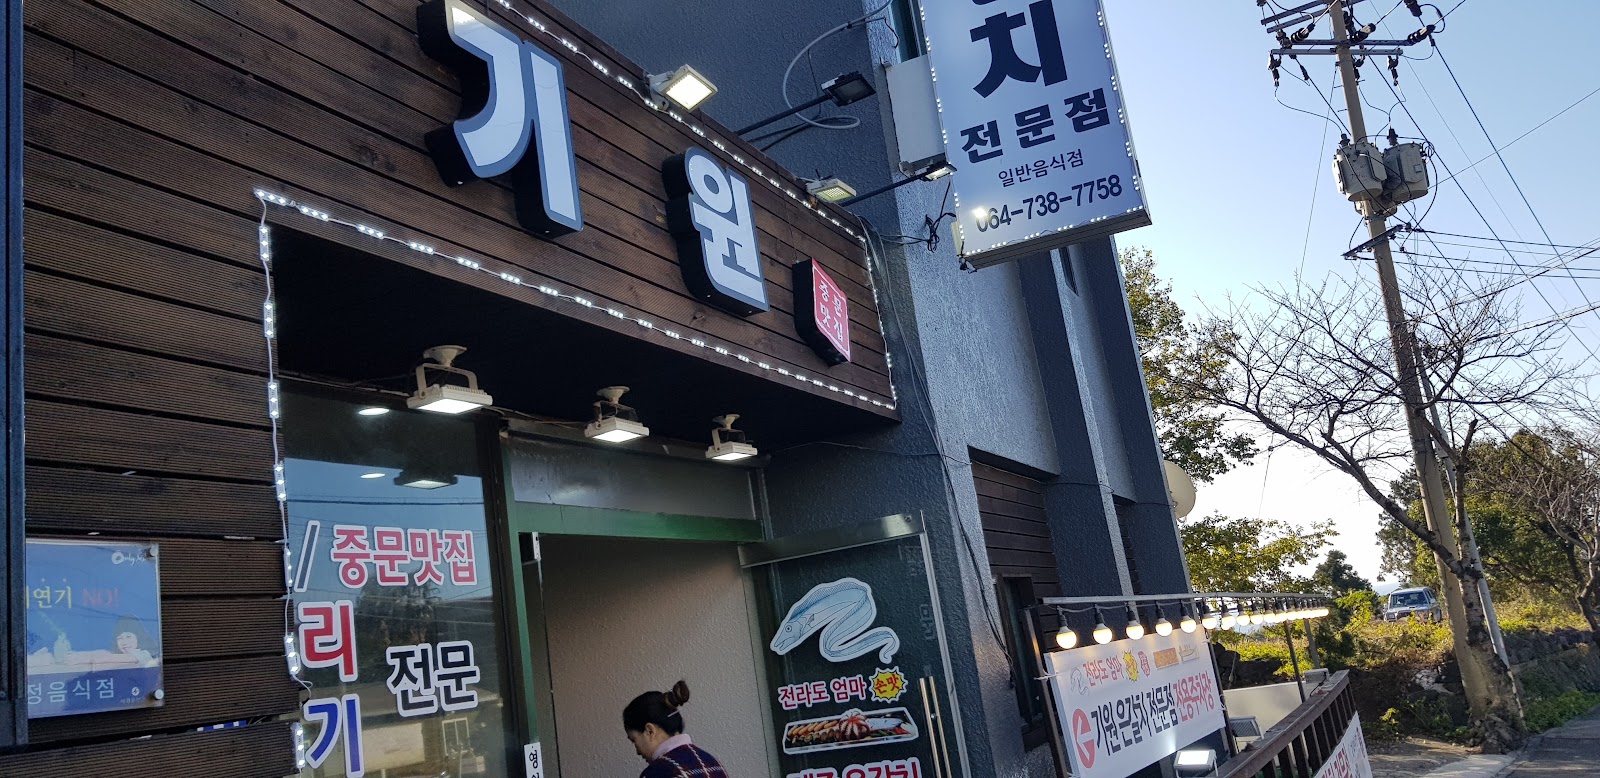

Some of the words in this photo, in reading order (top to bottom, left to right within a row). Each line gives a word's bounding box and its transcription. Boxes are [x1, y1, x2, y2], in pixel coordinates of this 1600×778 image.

[969, 0, 1068, 98] 치
[960, 88, 1110, 164] 전문점
[998, 149, 1084, 187] 일반음식점
[975, 174, 1122, 233] 064-738-7758
[332, 524, 477, 588] 중문맛집
[24, 585, 72, 608] 연기
[82, 587, 119, 608] NO!
[387, 641, 480, 717] 전문
[778, 682, 829, 709] 전라도
[831, 675, 867, 701] 엄마
[873, 673, 904, 694] 손맛
[1090, 701, 1122, 756] 기원
[1116, 691, 1152, 748] 은갈치
[1146, 682, 1179, 734] 전문점
[1173, 670, 1215, 723] 전용주차장
